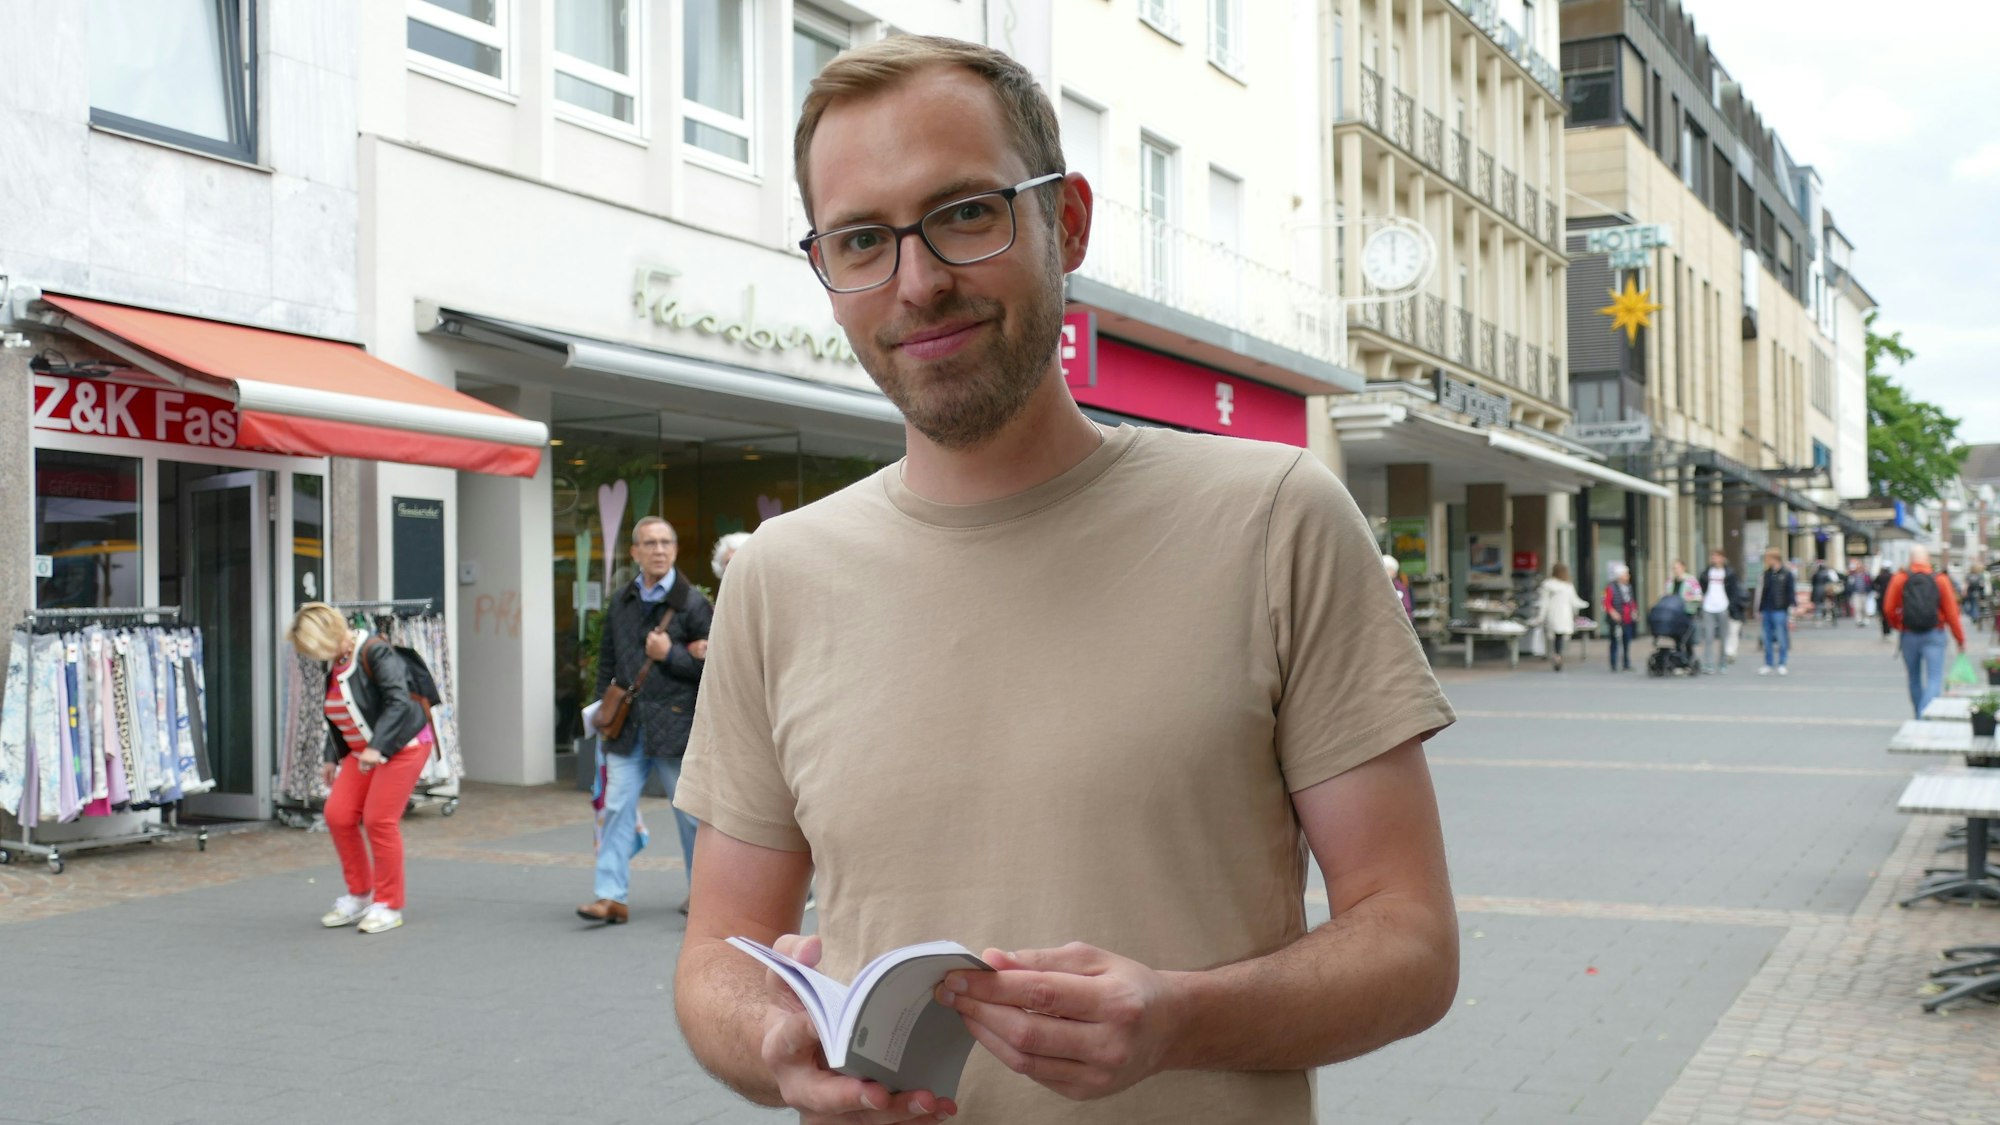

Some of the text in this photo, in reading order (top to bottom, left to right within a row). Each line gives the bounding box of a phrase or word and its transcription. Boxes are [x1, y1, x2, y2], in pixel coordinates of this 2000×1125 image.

[1586, 225, 1669, 253] HOTEL
[35, 374, 236, 448] Z&K Fas
[1215, 381, 1234, 426] T
